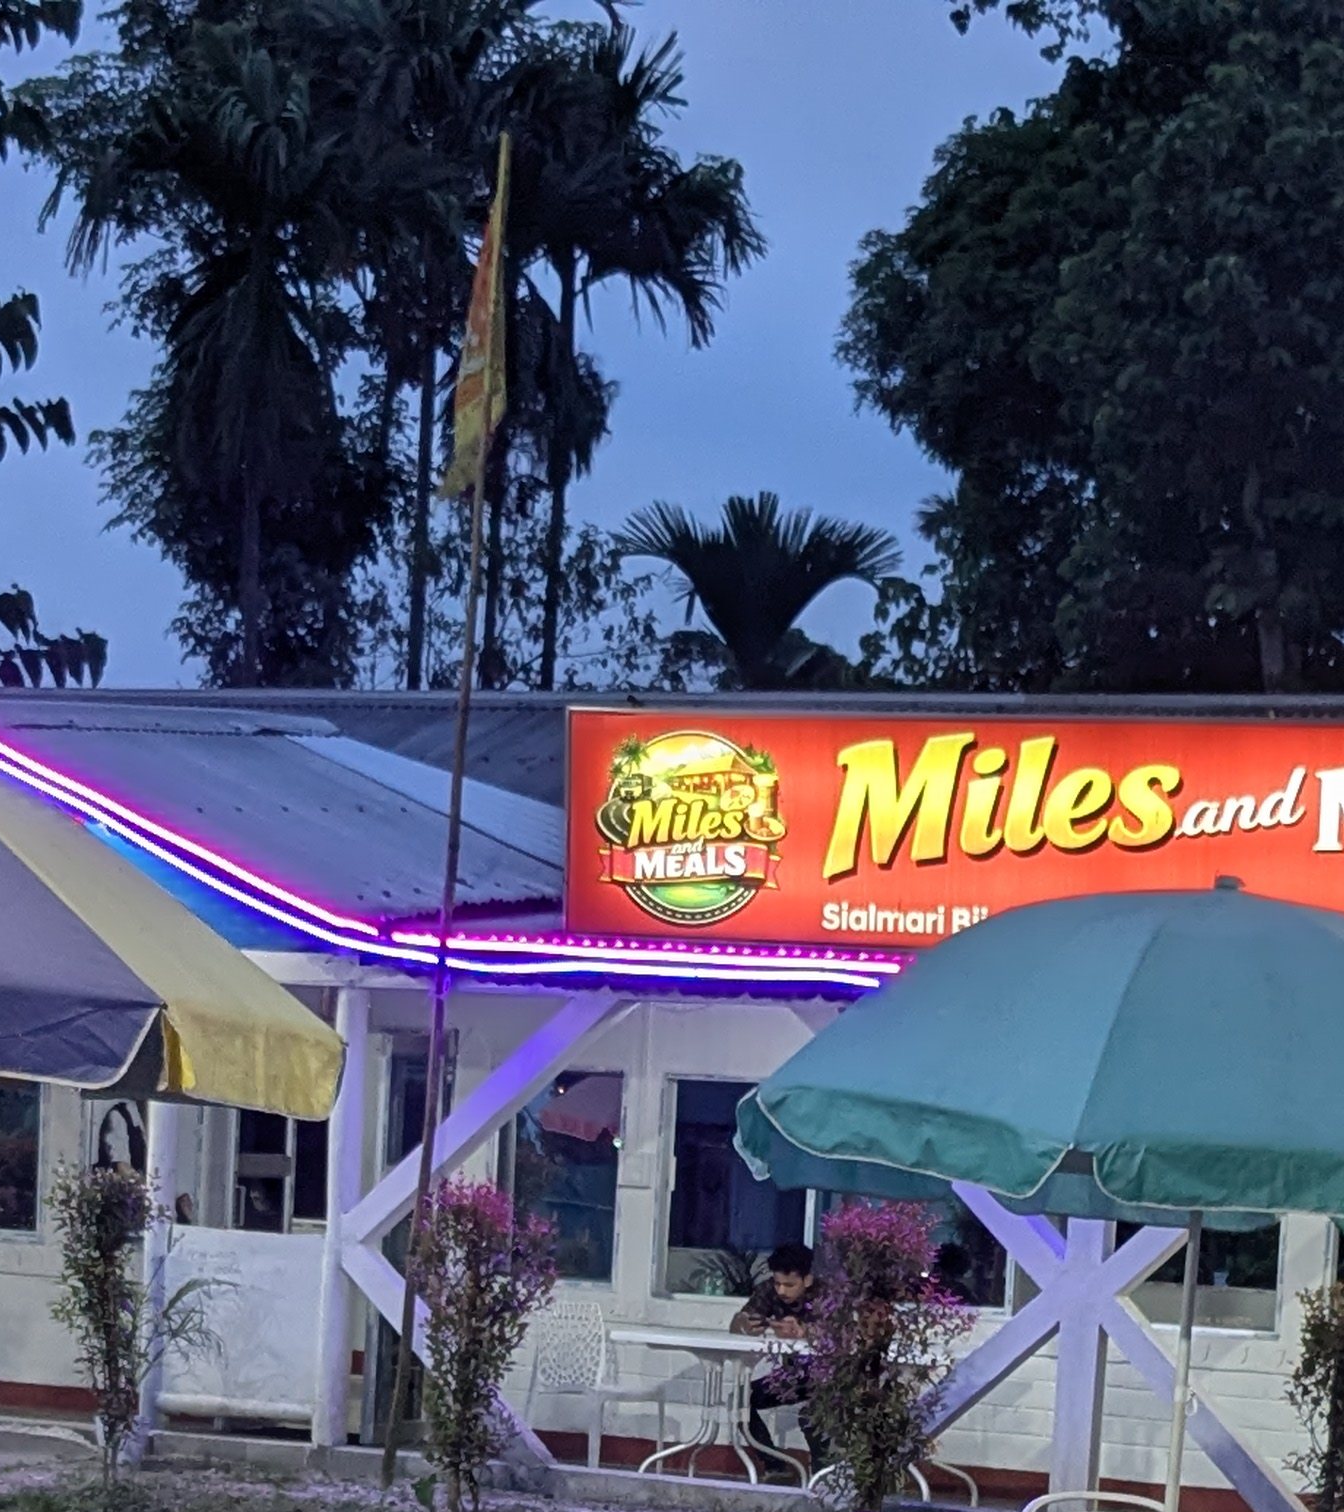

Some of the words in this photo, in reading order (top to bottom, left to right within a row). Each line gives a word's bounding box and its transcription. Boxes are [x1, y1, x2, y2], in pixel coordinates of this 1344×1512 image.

[627, 798, 744, 848] Miles
[822, 732, 1182, 881] Miles
[1175, 765, 1306, 838] and
[634, 845, 746, 880] MEALS
[671, 835, 705, 855] and
[821, 901, 946, 935] Sialmari
